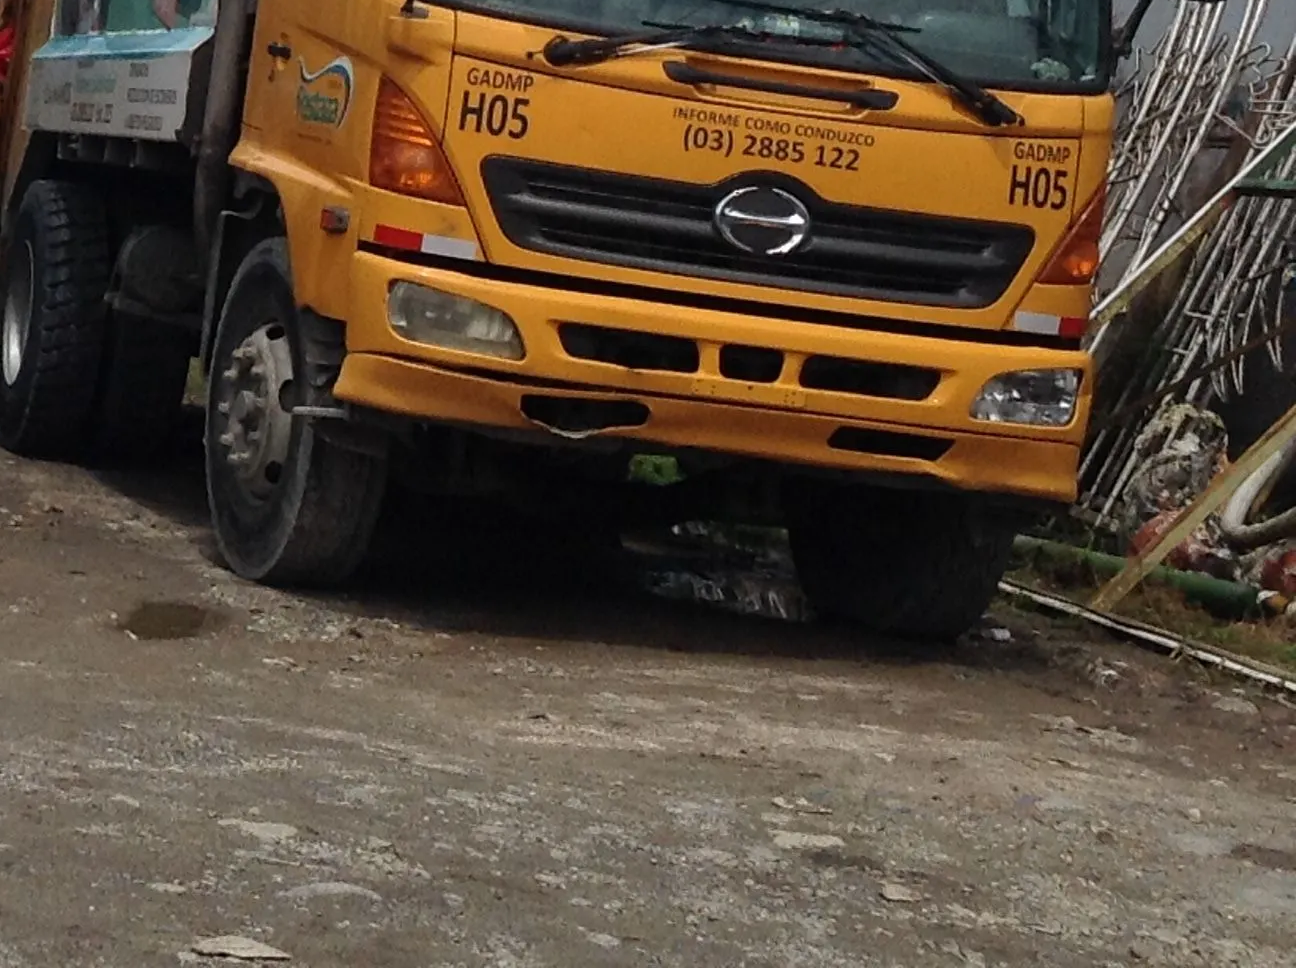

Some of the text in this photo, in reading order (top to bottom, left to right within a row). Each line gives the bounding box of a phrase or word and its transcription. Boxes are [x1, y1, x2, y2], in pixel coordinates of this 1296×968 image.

[467, 67, 534, 92] GADMP
[459, 90, 530, 139] H05
[672, 107, 875, 147] INFORME COMO CONDUZCO
[684, 124, 860, 171] (03) 2885 122
[1013, 141, 1071, 164] GADMP
[1009, 164, 1068, 210] H05
